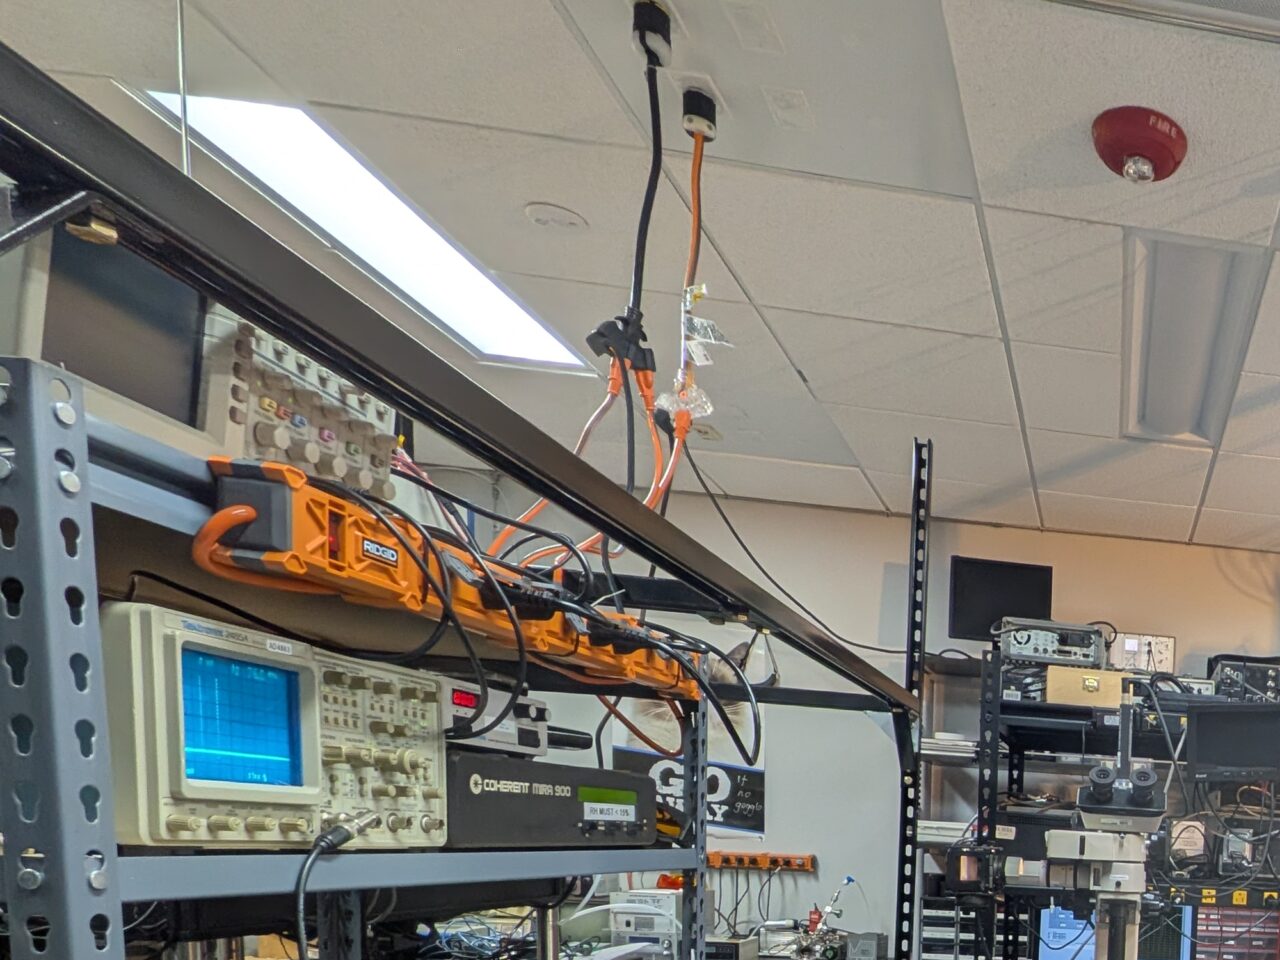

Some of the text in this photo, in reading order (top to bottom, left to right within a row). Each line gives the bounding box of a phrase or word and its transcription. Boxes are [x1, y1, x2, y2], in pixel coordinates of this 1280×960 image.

[1149, 115, 1177, 138] FIRE
[364, 540, 397, 561] RIDGID
[483, 779, 530, 794] COHERENT
[554, 785, 571, 797] 900
[648, 759, 731, 802] GO
